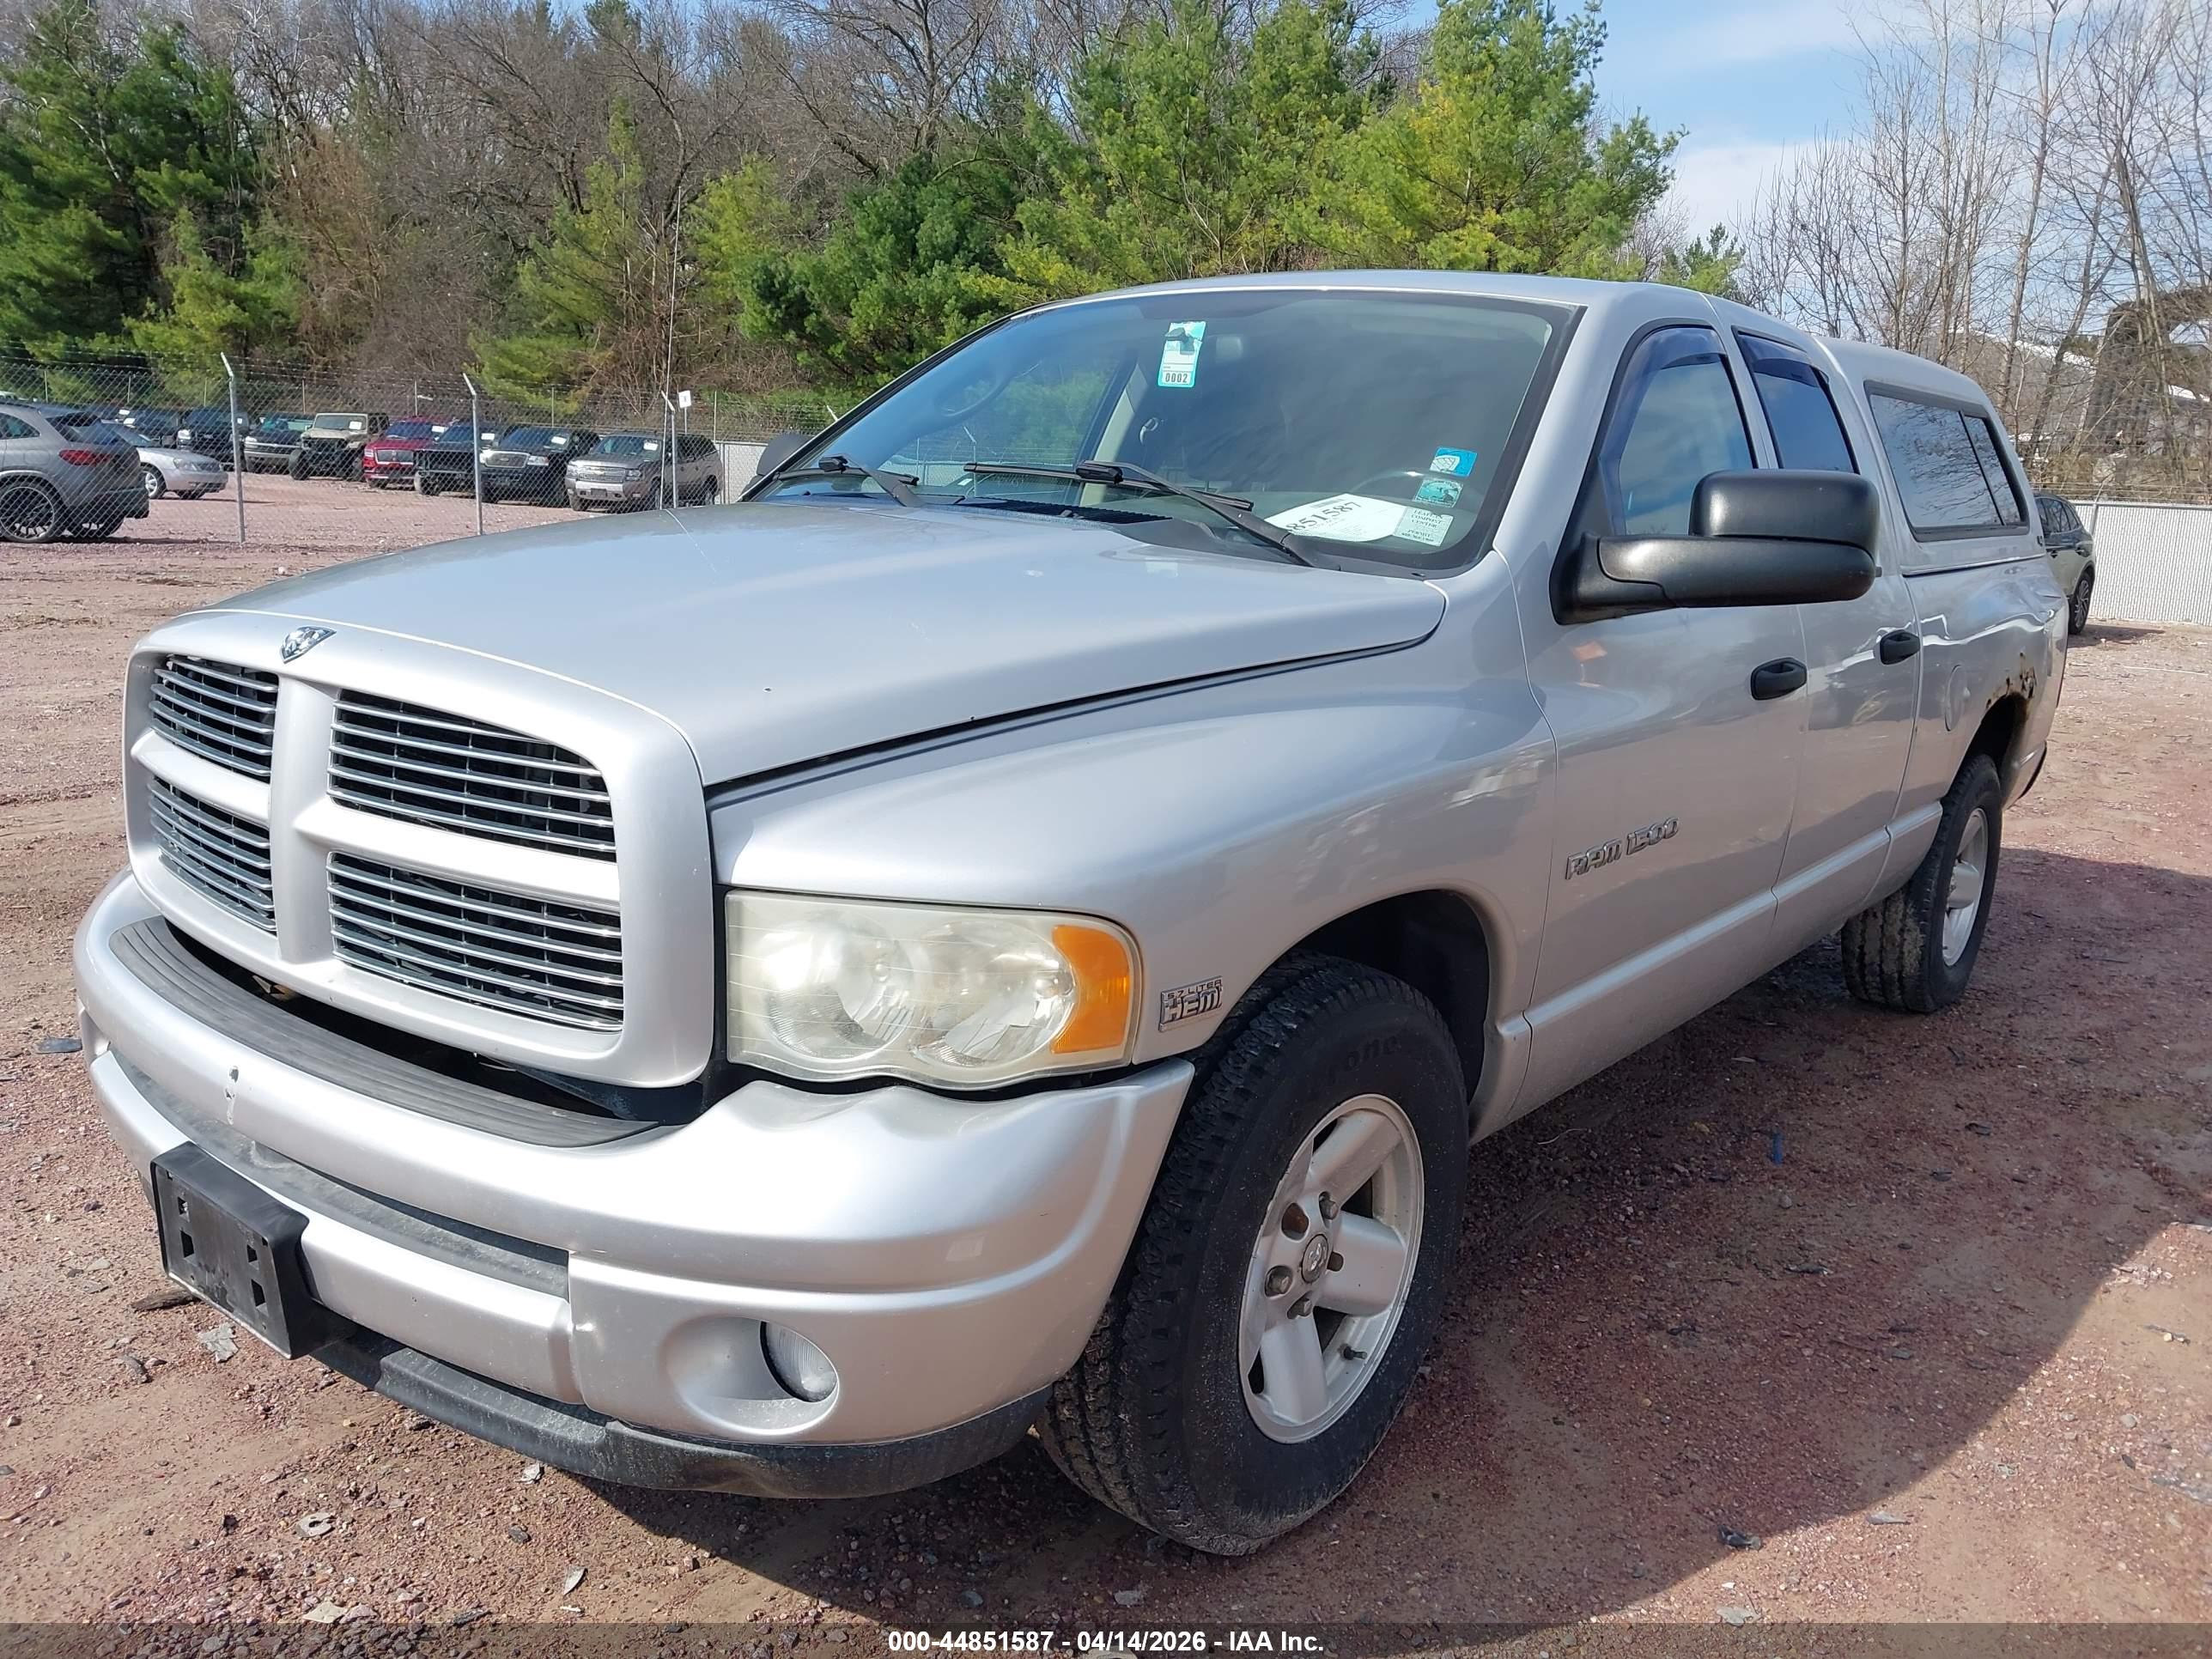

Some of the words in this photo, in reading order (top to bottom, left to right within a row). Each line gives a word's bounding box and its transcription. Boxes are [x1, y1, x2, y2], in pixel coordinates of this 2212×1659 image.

[1165, 373, 1188, 383] 0002
[1565, 839, 1622, 880] RAM
[1626, 817, 1679, 855] 1500
